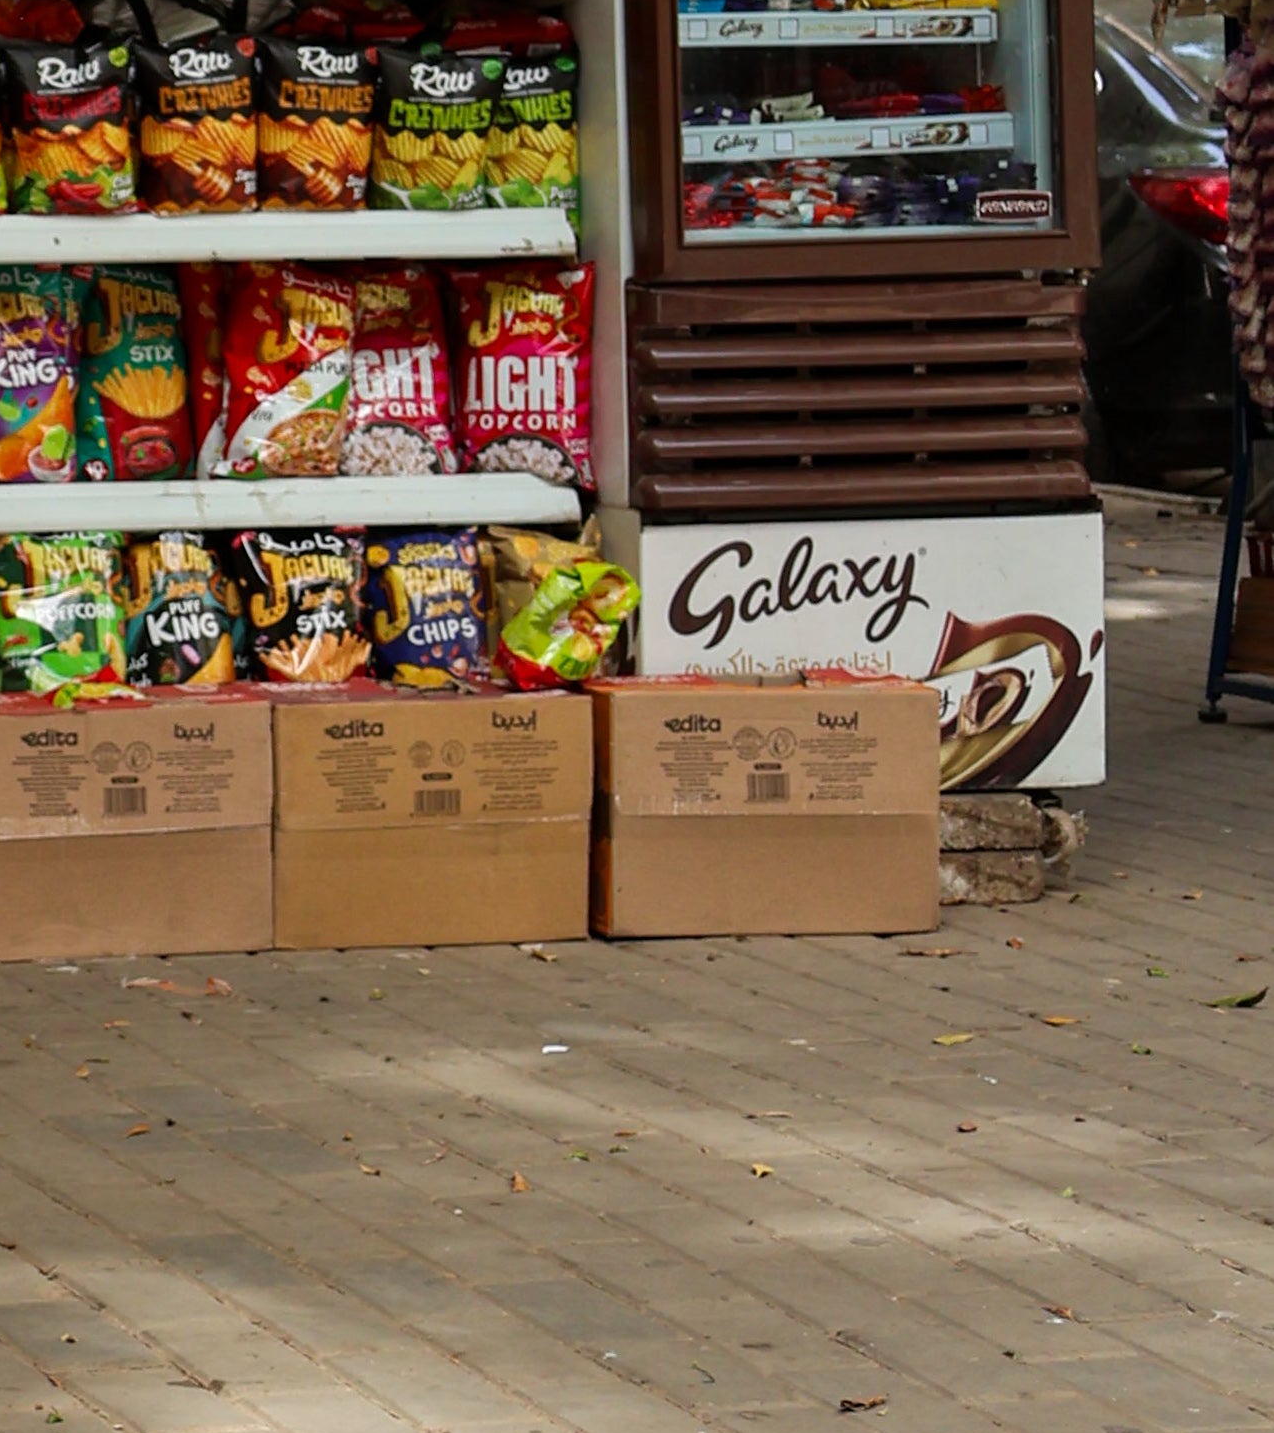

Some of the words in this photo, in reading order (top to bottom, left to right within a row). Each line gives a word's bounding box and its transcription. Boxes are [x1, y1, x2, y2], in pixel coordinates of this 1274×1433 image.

[297, 47, 359, 78] Raw
[410, 62, 475, 97] Raw
[130, 345, 174, 363] STIX
[466, 355, 578, 412] LIGHT
[467, 412, 577, 430] POPCORN
[668, 535, 930, 651] Galaxy
[147, 612, 219, 645] KING
[296, 610, 348, 633] STIX
[407, 618, 477, 647] CHIPS
[324, 719, 384, 739] edita
[663, 716, 721, 733] edita
